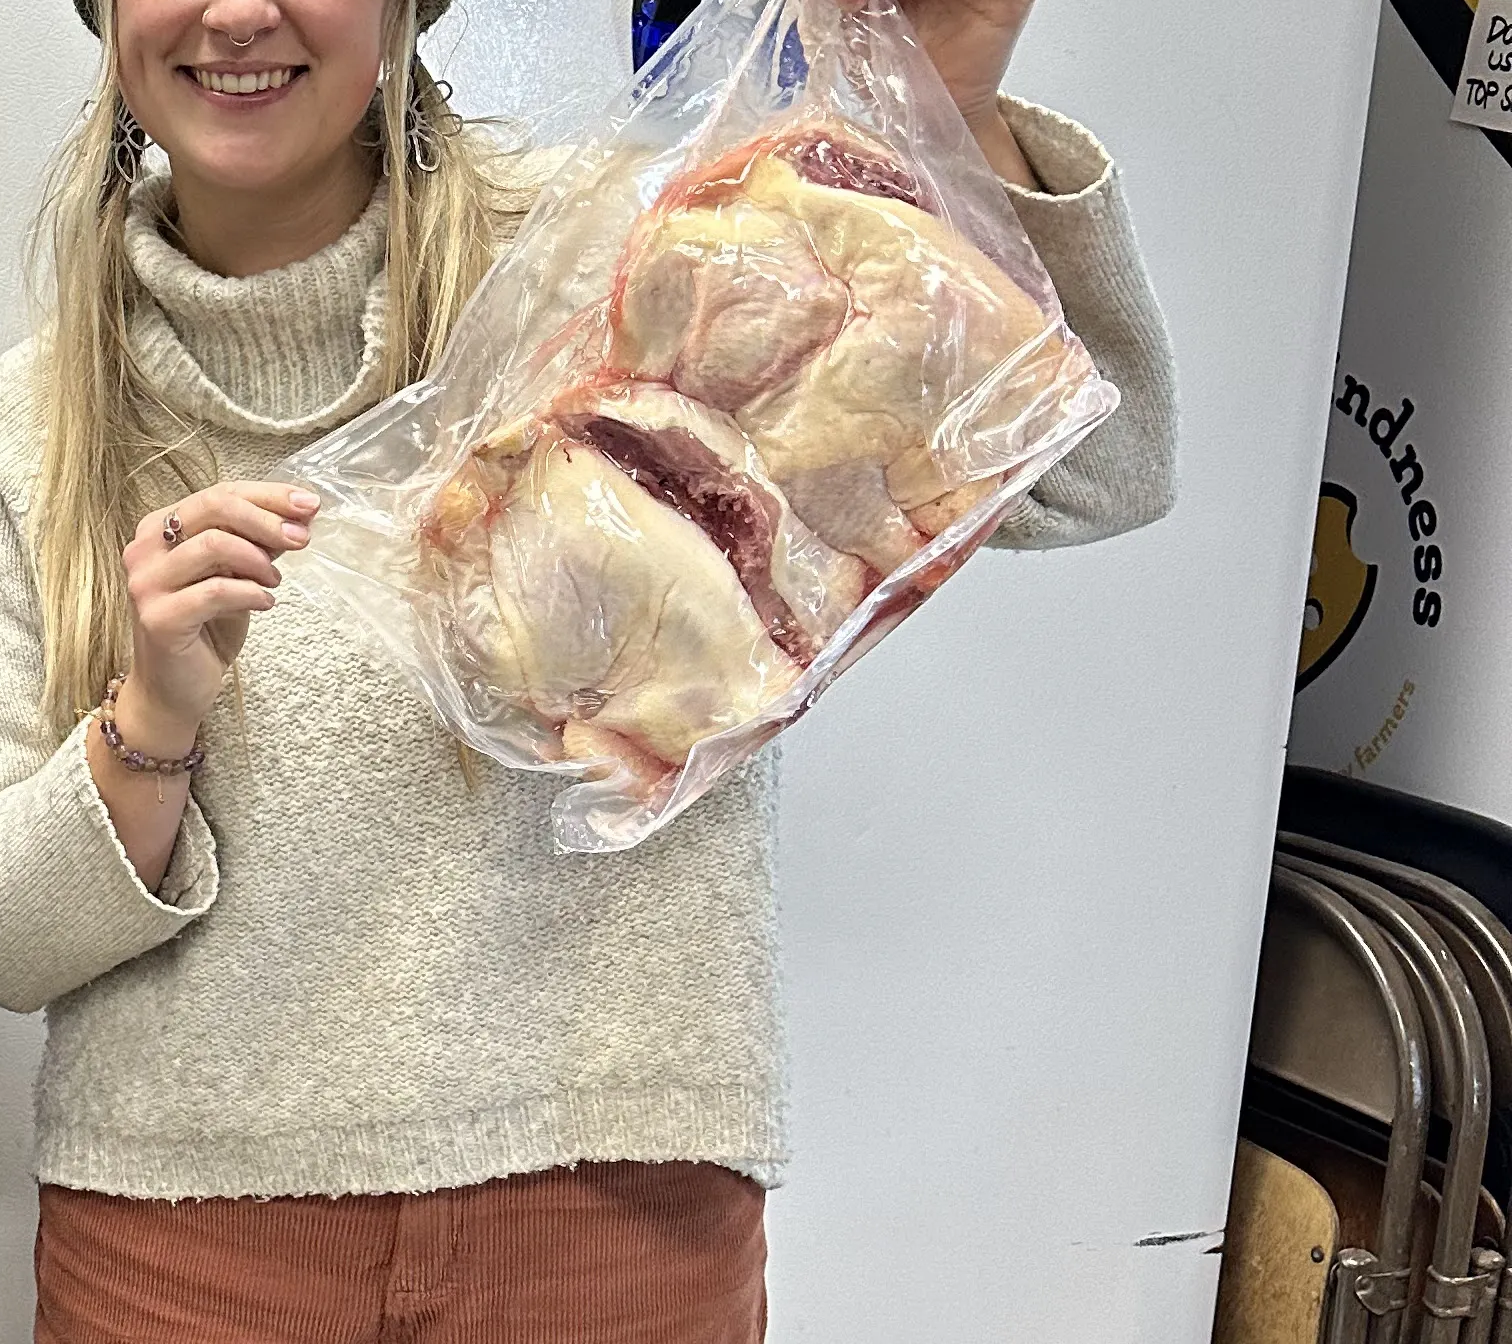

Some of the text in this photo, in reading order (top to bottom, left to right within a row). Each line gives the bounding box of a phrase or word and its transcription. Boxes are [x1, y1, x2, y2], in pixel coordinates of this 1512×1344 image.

[1466, 78, 1499, 110] TOP
[1332, 373, 1444, 630] ndness
[1353, 678, 1416, 771] farmers
